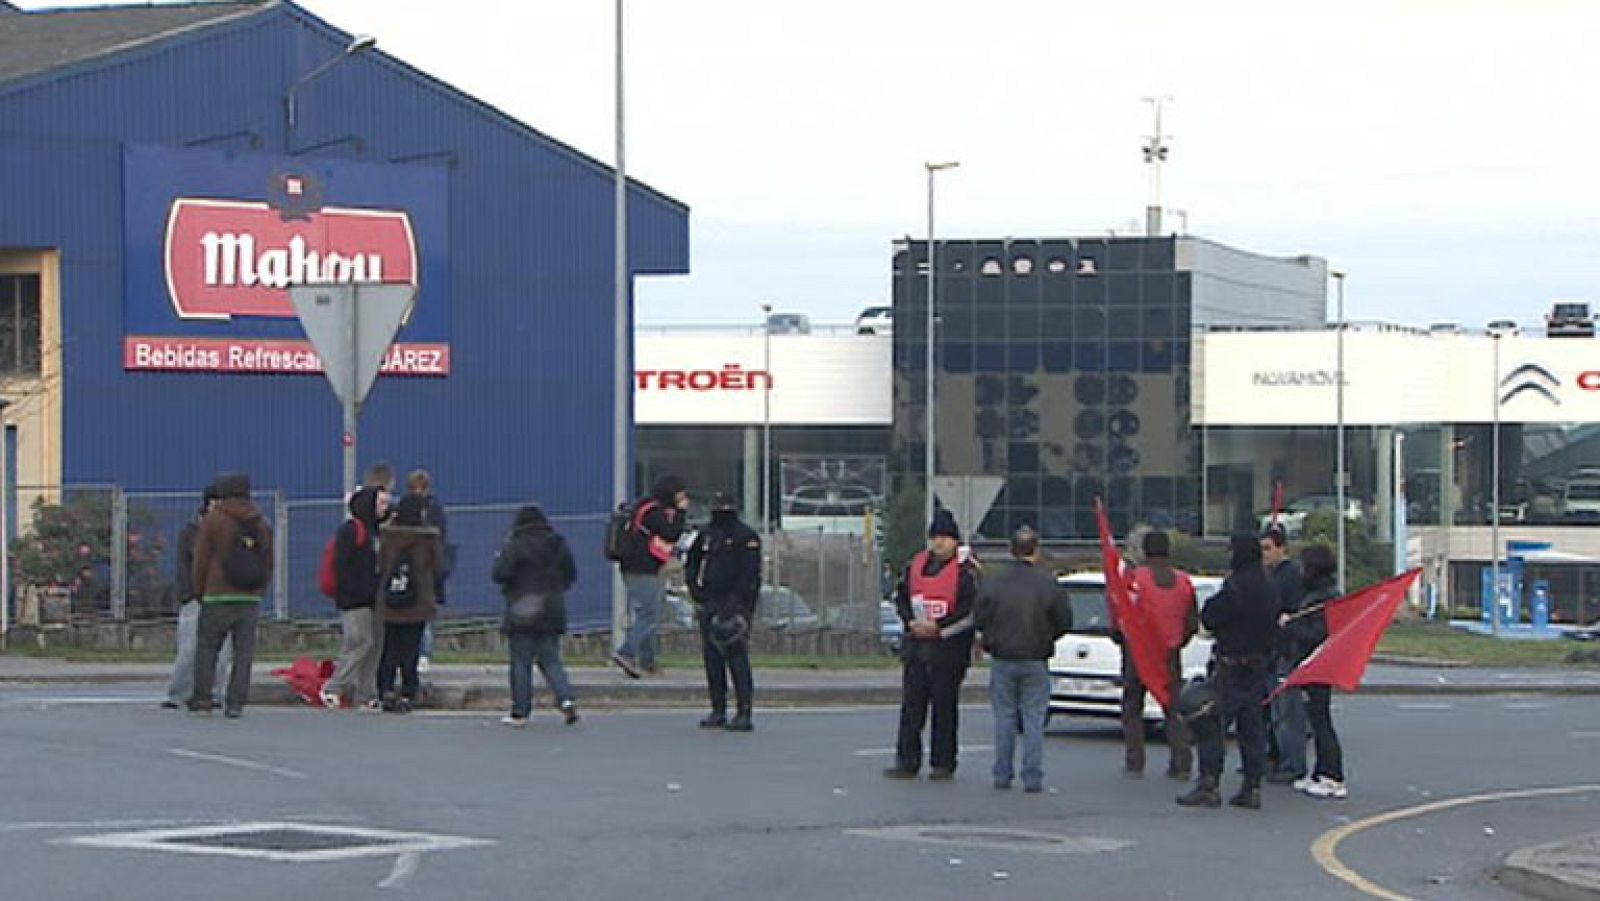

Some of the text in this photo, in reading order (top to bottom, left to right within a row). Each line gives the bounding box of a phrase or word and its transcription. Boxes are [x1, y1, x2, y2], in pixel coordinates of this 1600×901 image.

[200, 231, 383, 287] Mahou
[135, 343, 220, 368] Bebidas
[1252, 369, 1350, 387] NOVAMÓVL
